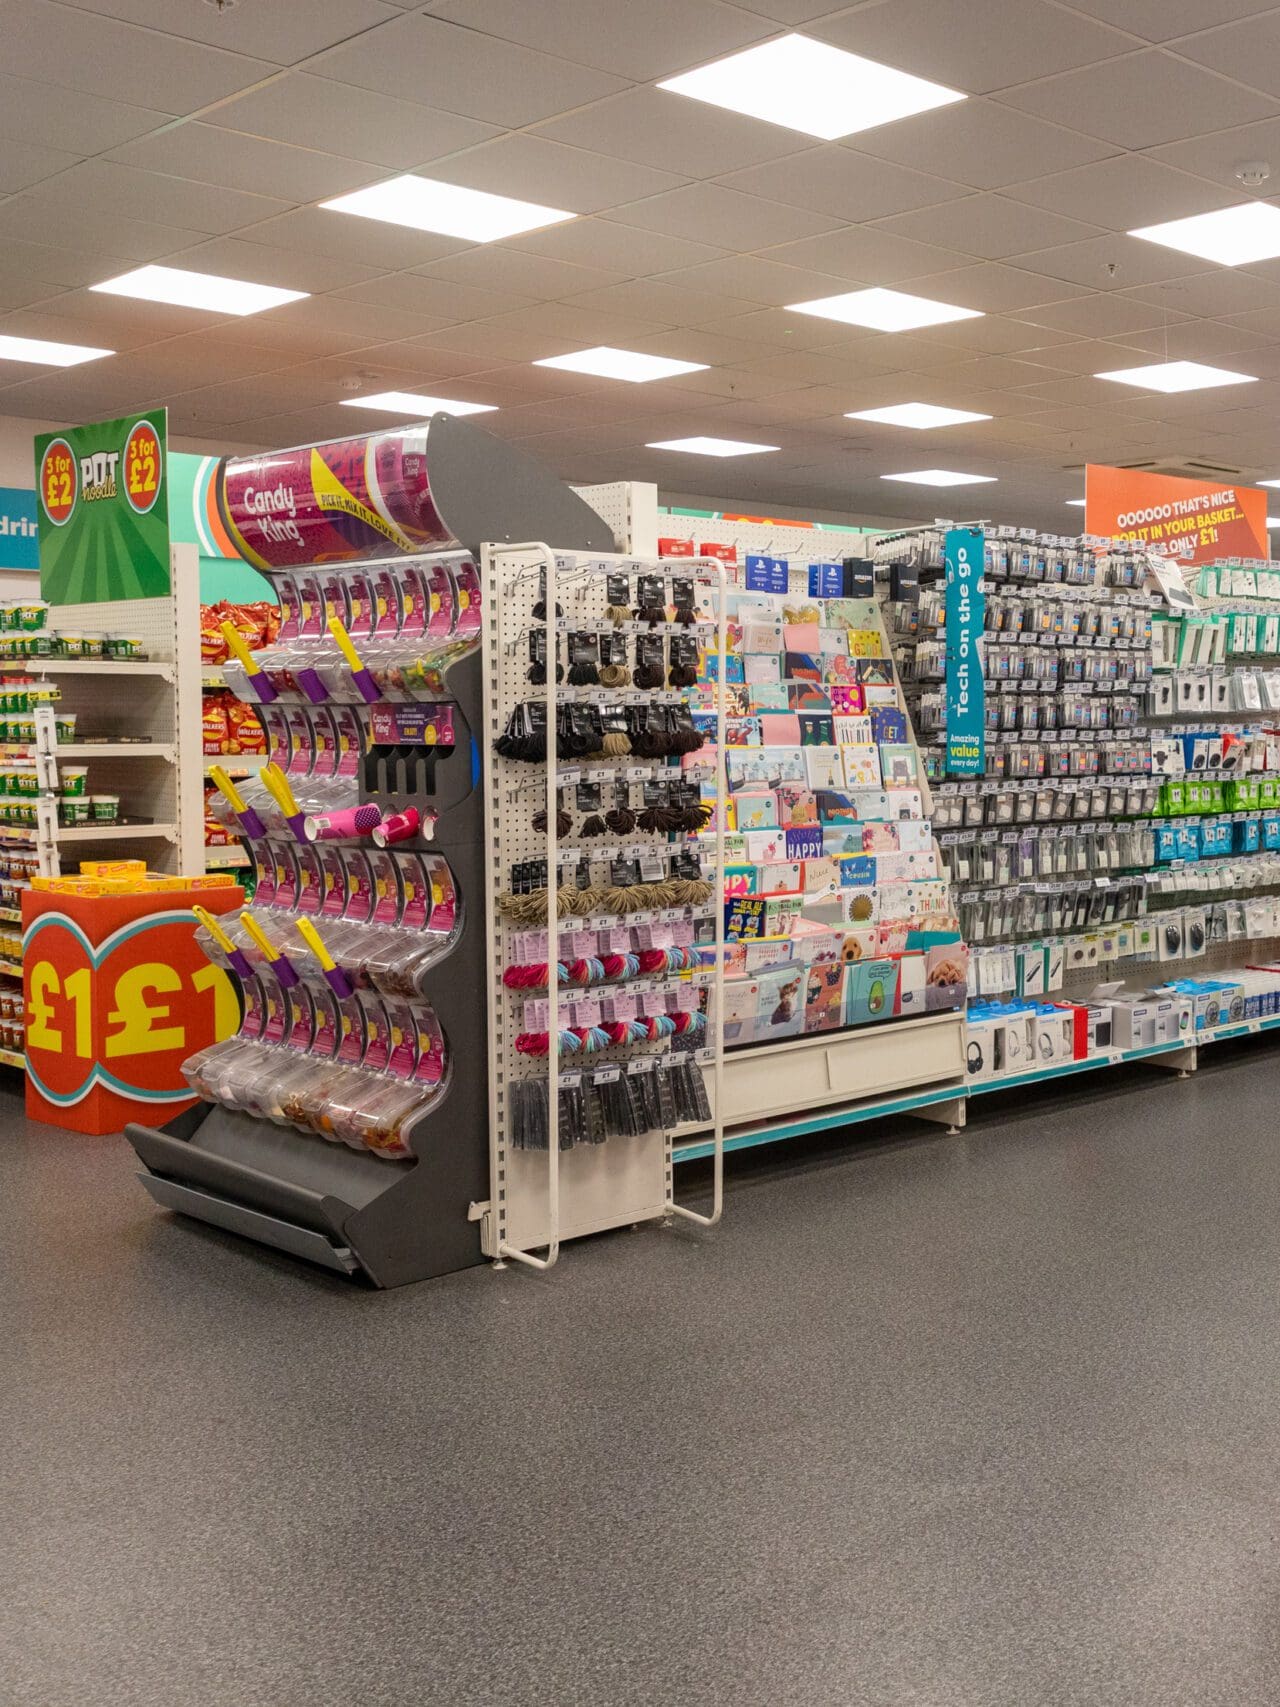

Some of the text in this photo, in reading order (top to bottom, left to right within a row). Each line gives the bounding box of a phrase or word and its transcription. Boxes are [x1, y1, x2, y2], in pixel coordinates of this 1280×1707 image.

[130, 439, 155, 458] 3 for
[47, 456, 70, 474] 3 for
[80, 452, 119, 488] POT
[130, 456, 156, 494] £2
[47, 473, 72, 508] £2
[81, 475, 118, 501] noodle
[244, 482, 297, 517] Candy
[1173, 495, 1210, 516] THAT'S
[1211, 490, 1235, 508] NICE
[256, 517, 305, 547] King
[370, 515, 394, 538] LOVE
[1137, 528, 1149, 541] IT
[1149, 524, 1163, 540] IN
[1164, 517, 1195, 536] YOUR
[1168, 533, 1199, 553] ONLY
[957, 547, 971, 717] Tech on the go
[372, 713, 391, 725] Candy
[375, 723, 390, 735] King
[950, 734, 979, 744] Amazing
[950, 744, 979, 757] value
[788, 842, 823, 859] HAPPY
[920, 898, 946, 912] THANK
[27, 960, 92, 1059] £1
[105, 961, 241, 1059] £1
